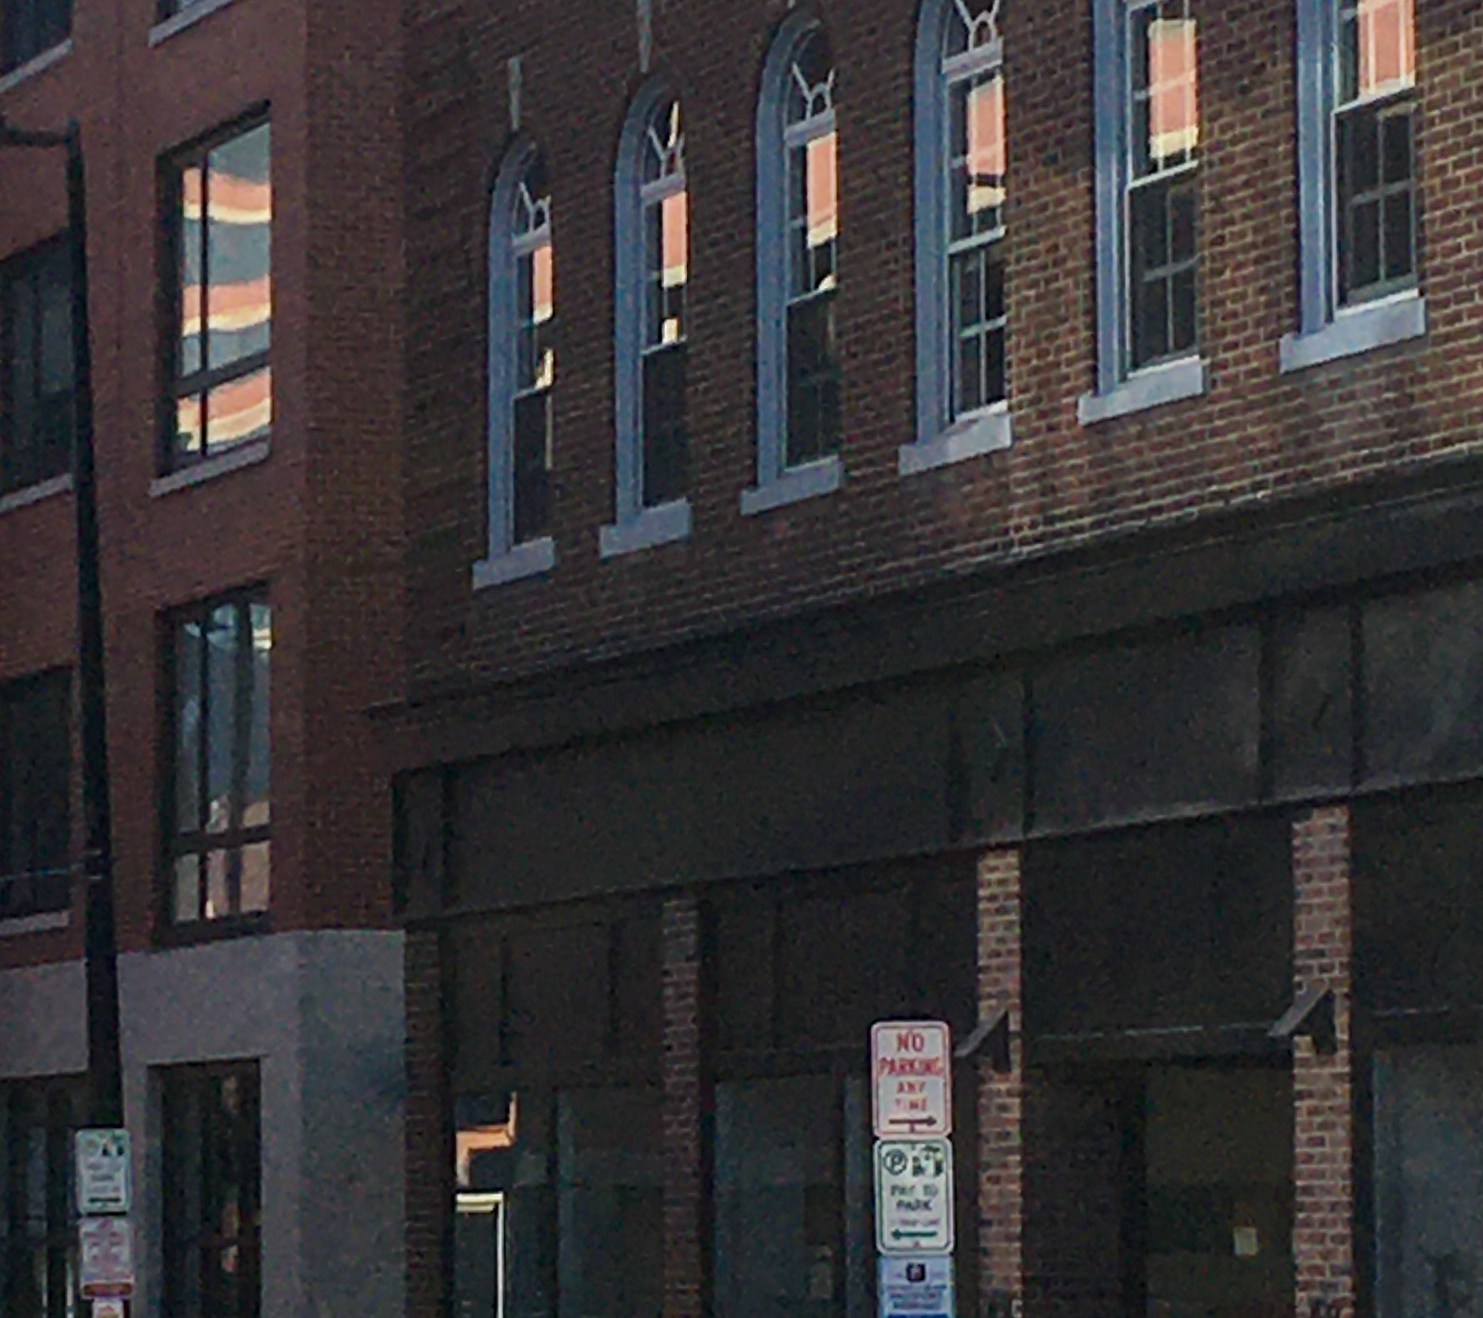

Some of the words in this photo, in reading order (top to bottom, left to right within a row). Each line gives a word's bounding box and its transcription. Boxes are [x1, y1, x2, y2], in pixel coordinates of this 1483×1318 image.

[897, 1032, 924, 1052] NO
[878, 1056, 943, 1076] PARKING
[897, 1081, 926, 1094] ANY
[895, 1097, 927, 1111] TIME
